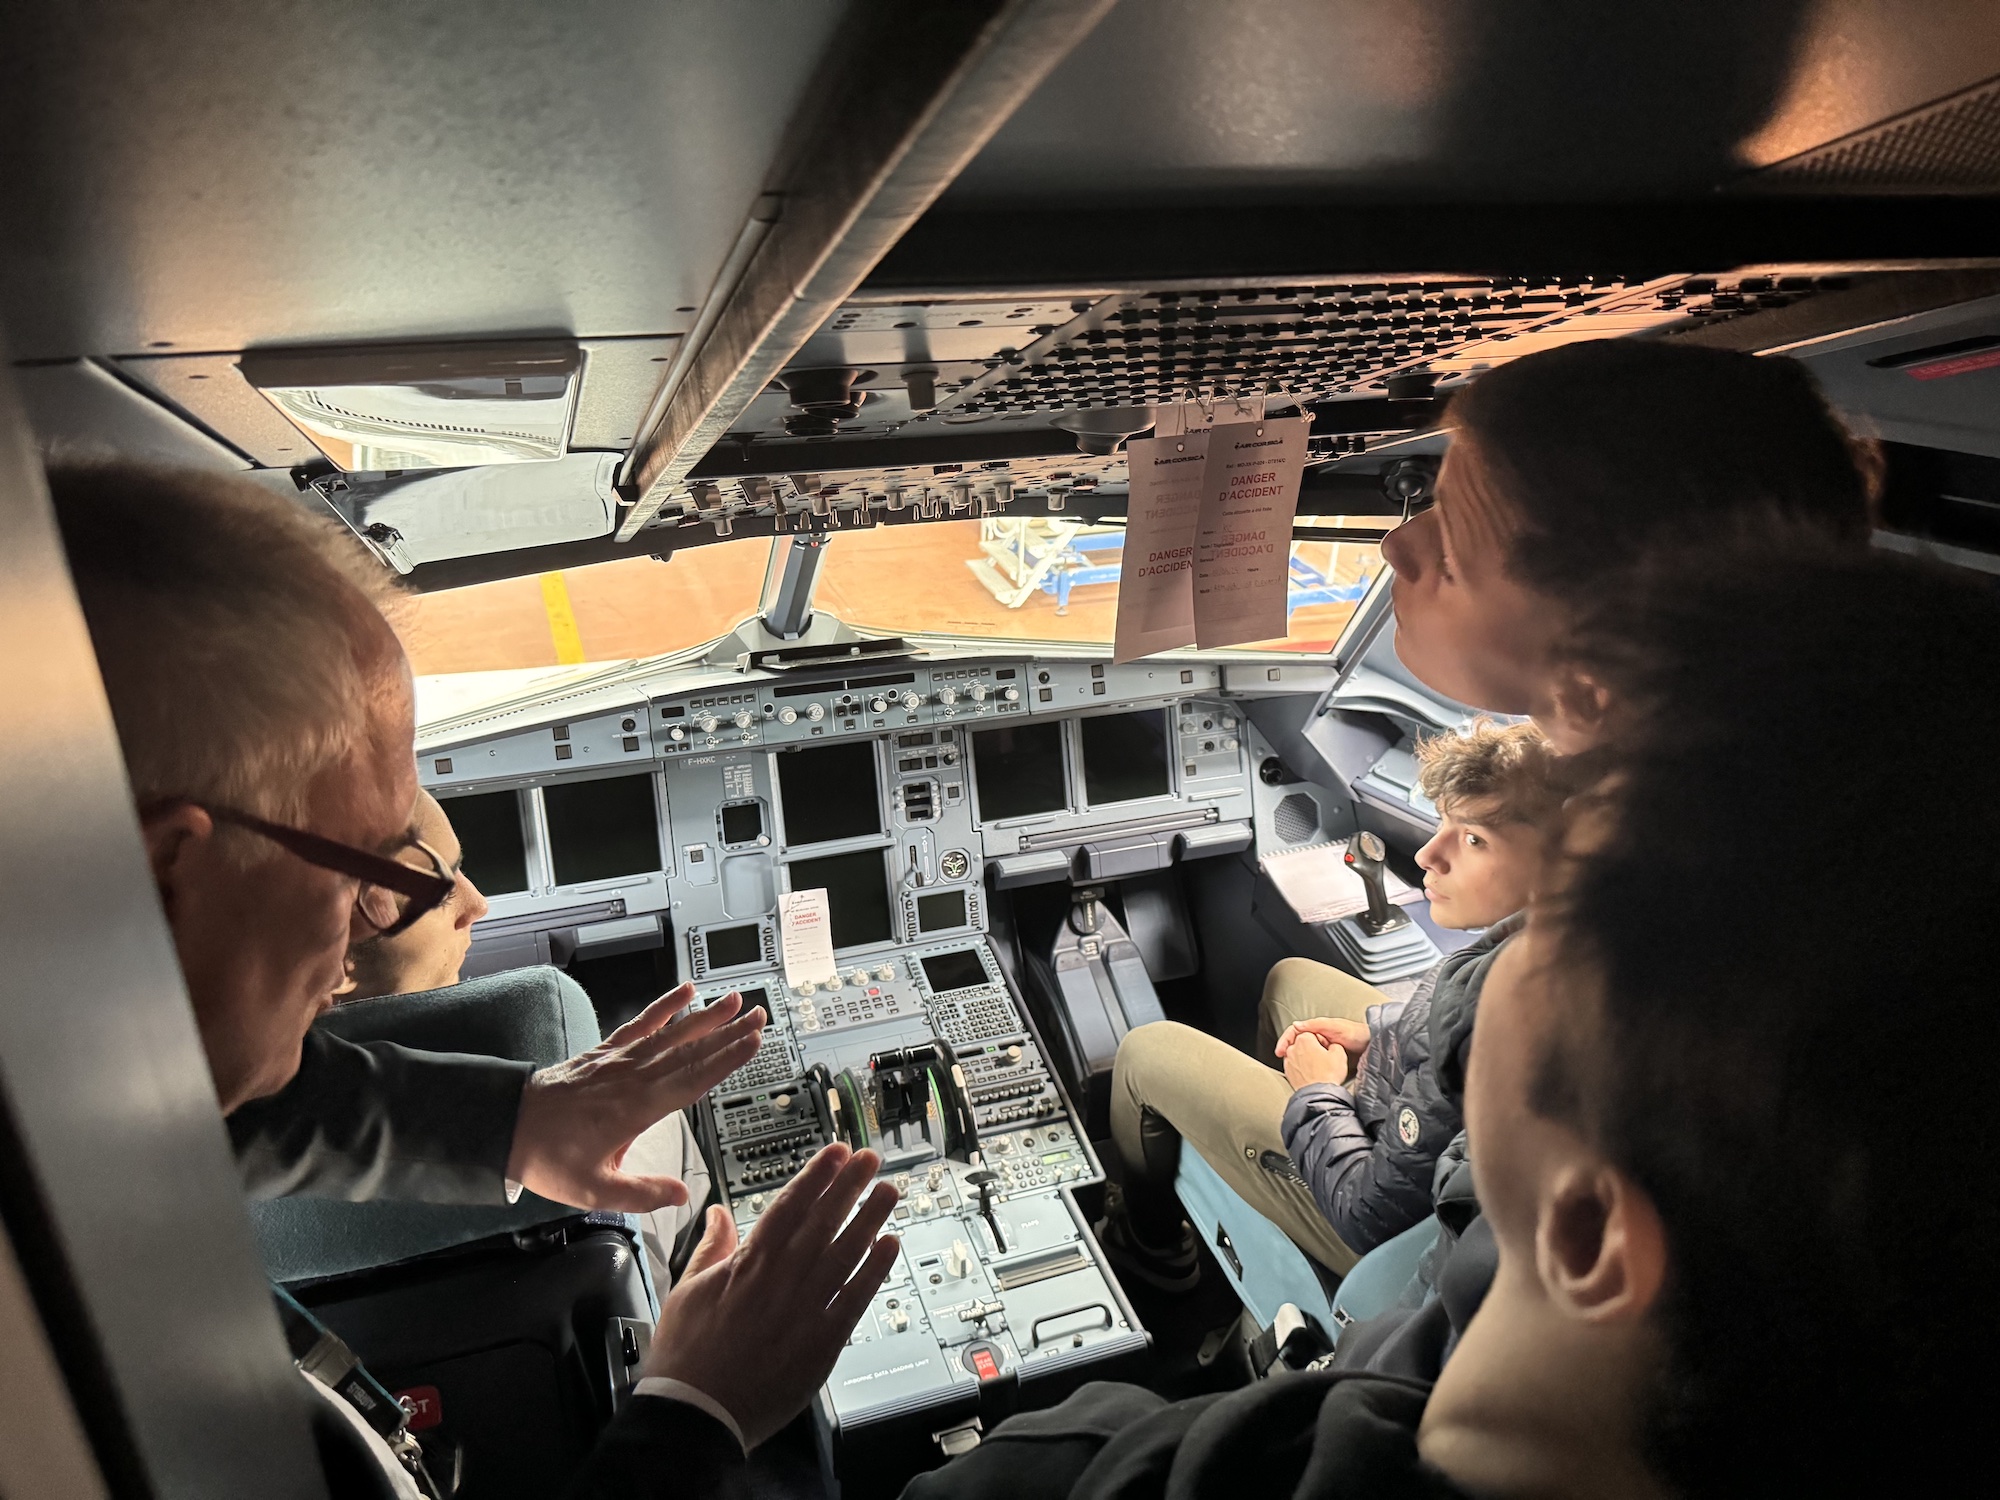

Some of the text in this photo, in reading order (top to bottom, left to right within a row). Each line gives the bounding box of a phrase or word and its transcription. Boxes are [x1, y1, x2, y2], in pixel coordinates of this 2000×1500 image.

[1172, 455, 1205, 463] CORSICA
[1231, 472, 1276, 487] DANGER
[1219, 485, 1284, 502] D'ACCIDENT
[1149, 546, 1193, 563] DANGER
[1138, 560, 1193, 578] D'ACCIDEN
[794, 912, 817, 920] DANGER
[961, 1306, 984, 1320] PARK
[984, 1300, 1003, 1314] BRK
[843, 1358, 930, 1386] AIRBORNE DATA LOADING UNIT
